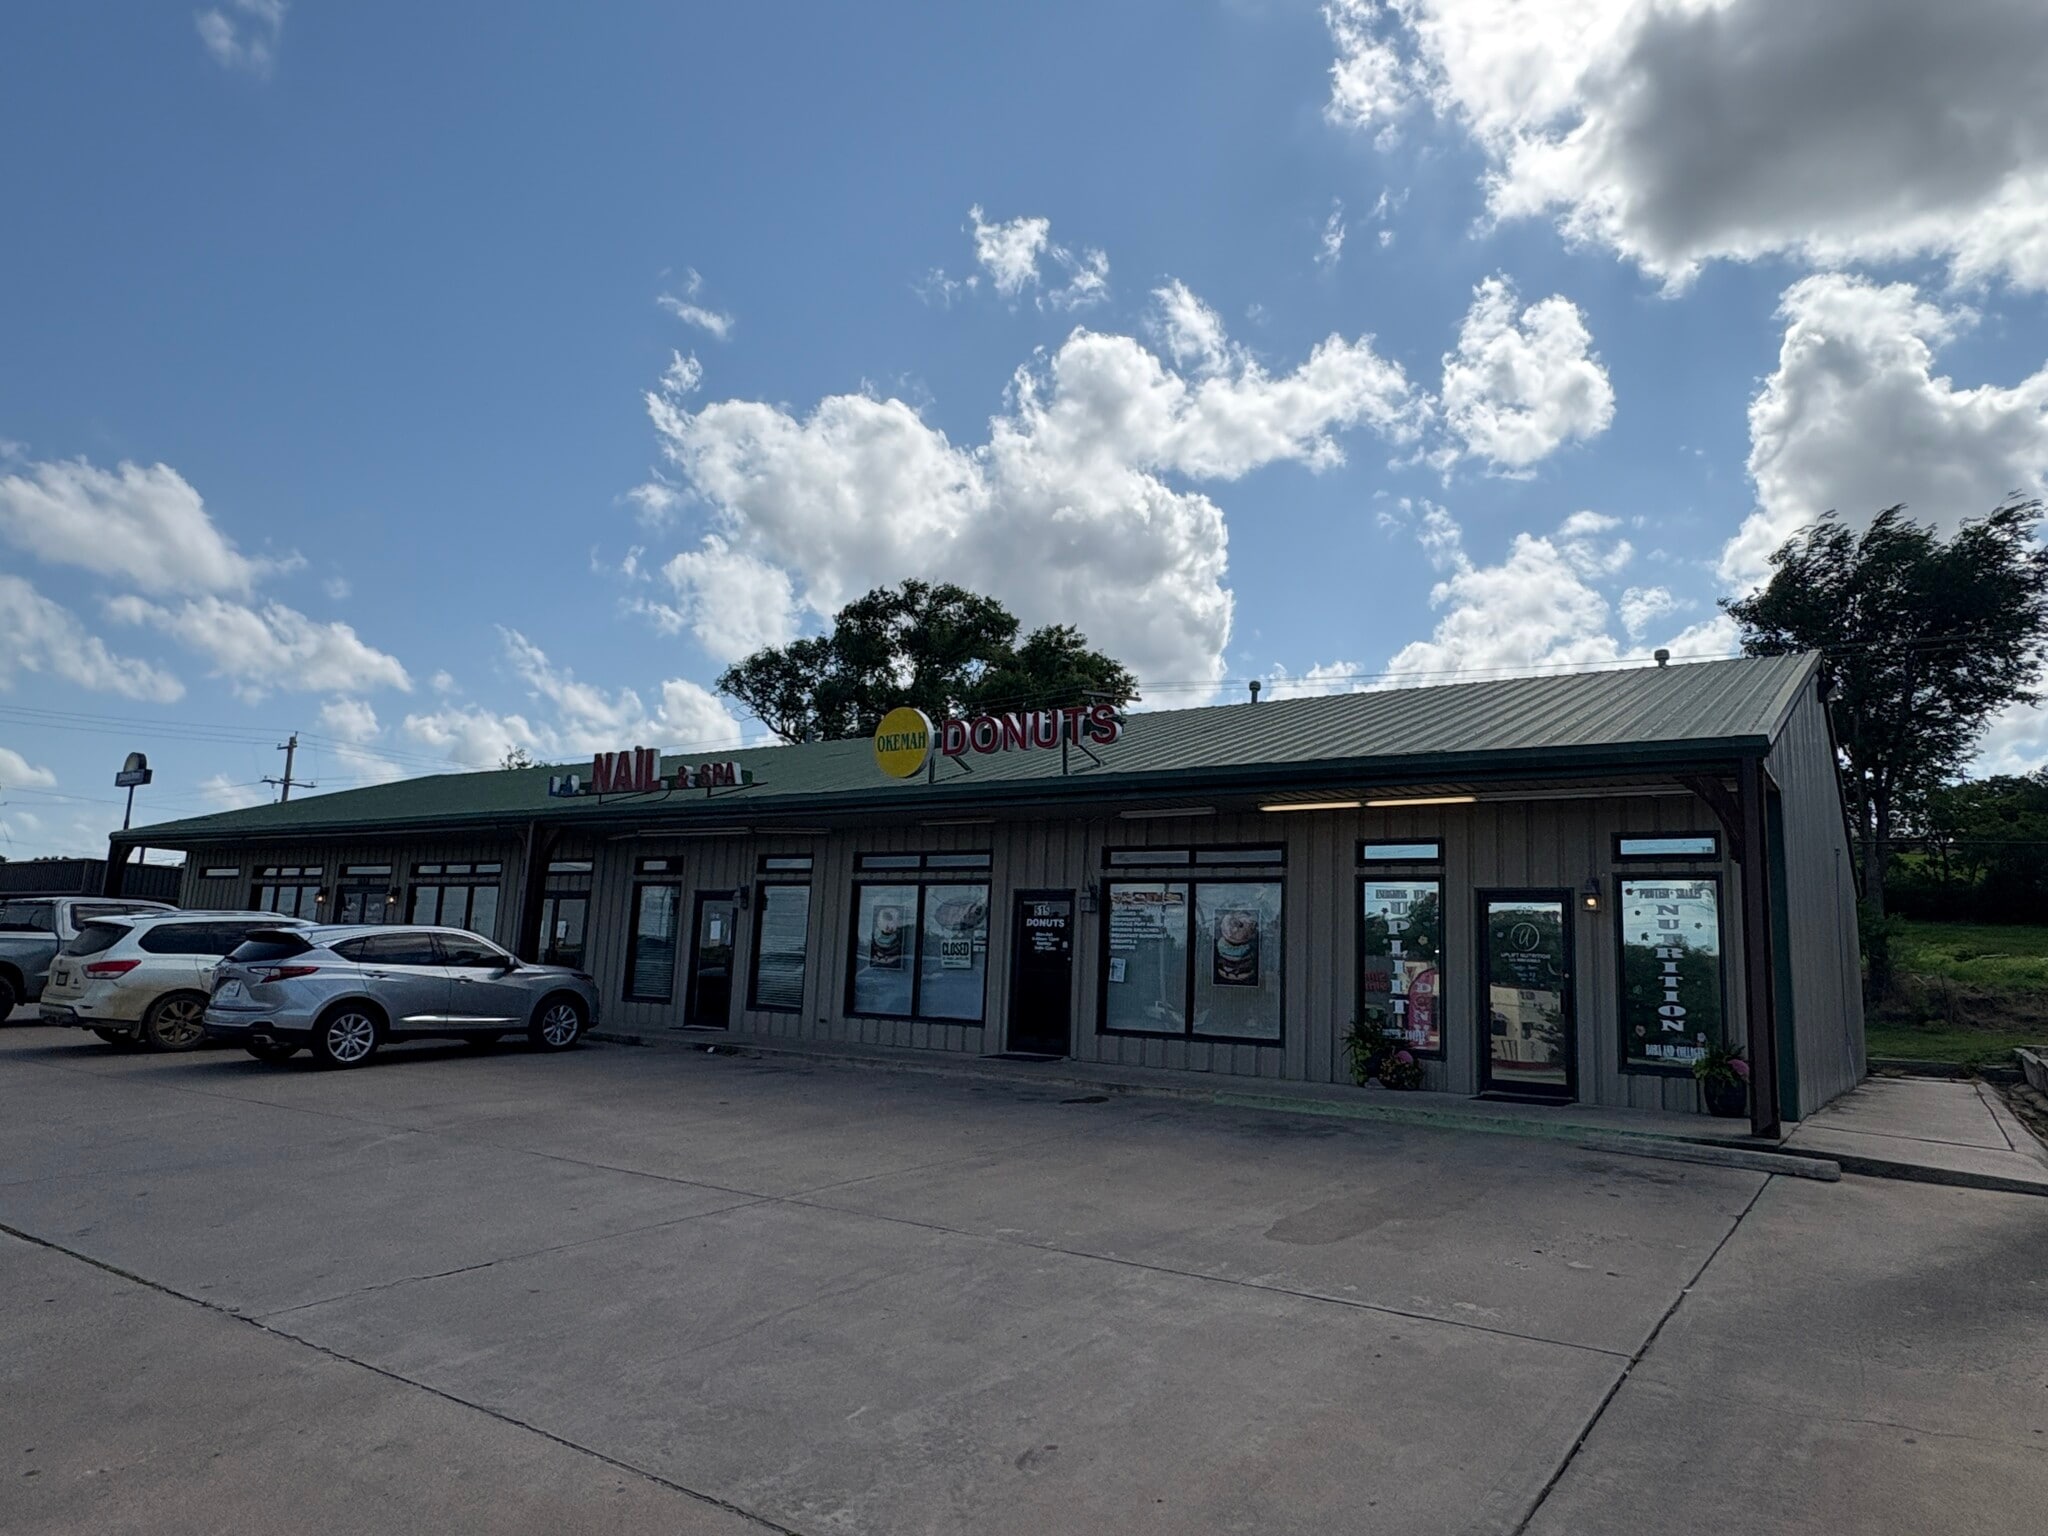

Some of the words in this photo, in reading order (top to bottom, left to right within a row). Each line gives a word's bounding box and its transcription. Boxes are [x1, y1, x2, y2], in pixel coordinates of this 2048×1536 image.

[877, 731, 926, 752] OKEMAH
[942, 703, 1121, 755] DONUTS
[591, 747, 664, 793] NAIL
[676, 765, 696, 788] &
[699, 761, 742, 787] SPA
[1026, 917, 1065, 928] DONUTS
[942, 942, 969, 956] CLOSED
[1656, 904, 1686, 1031] NUTRITION
